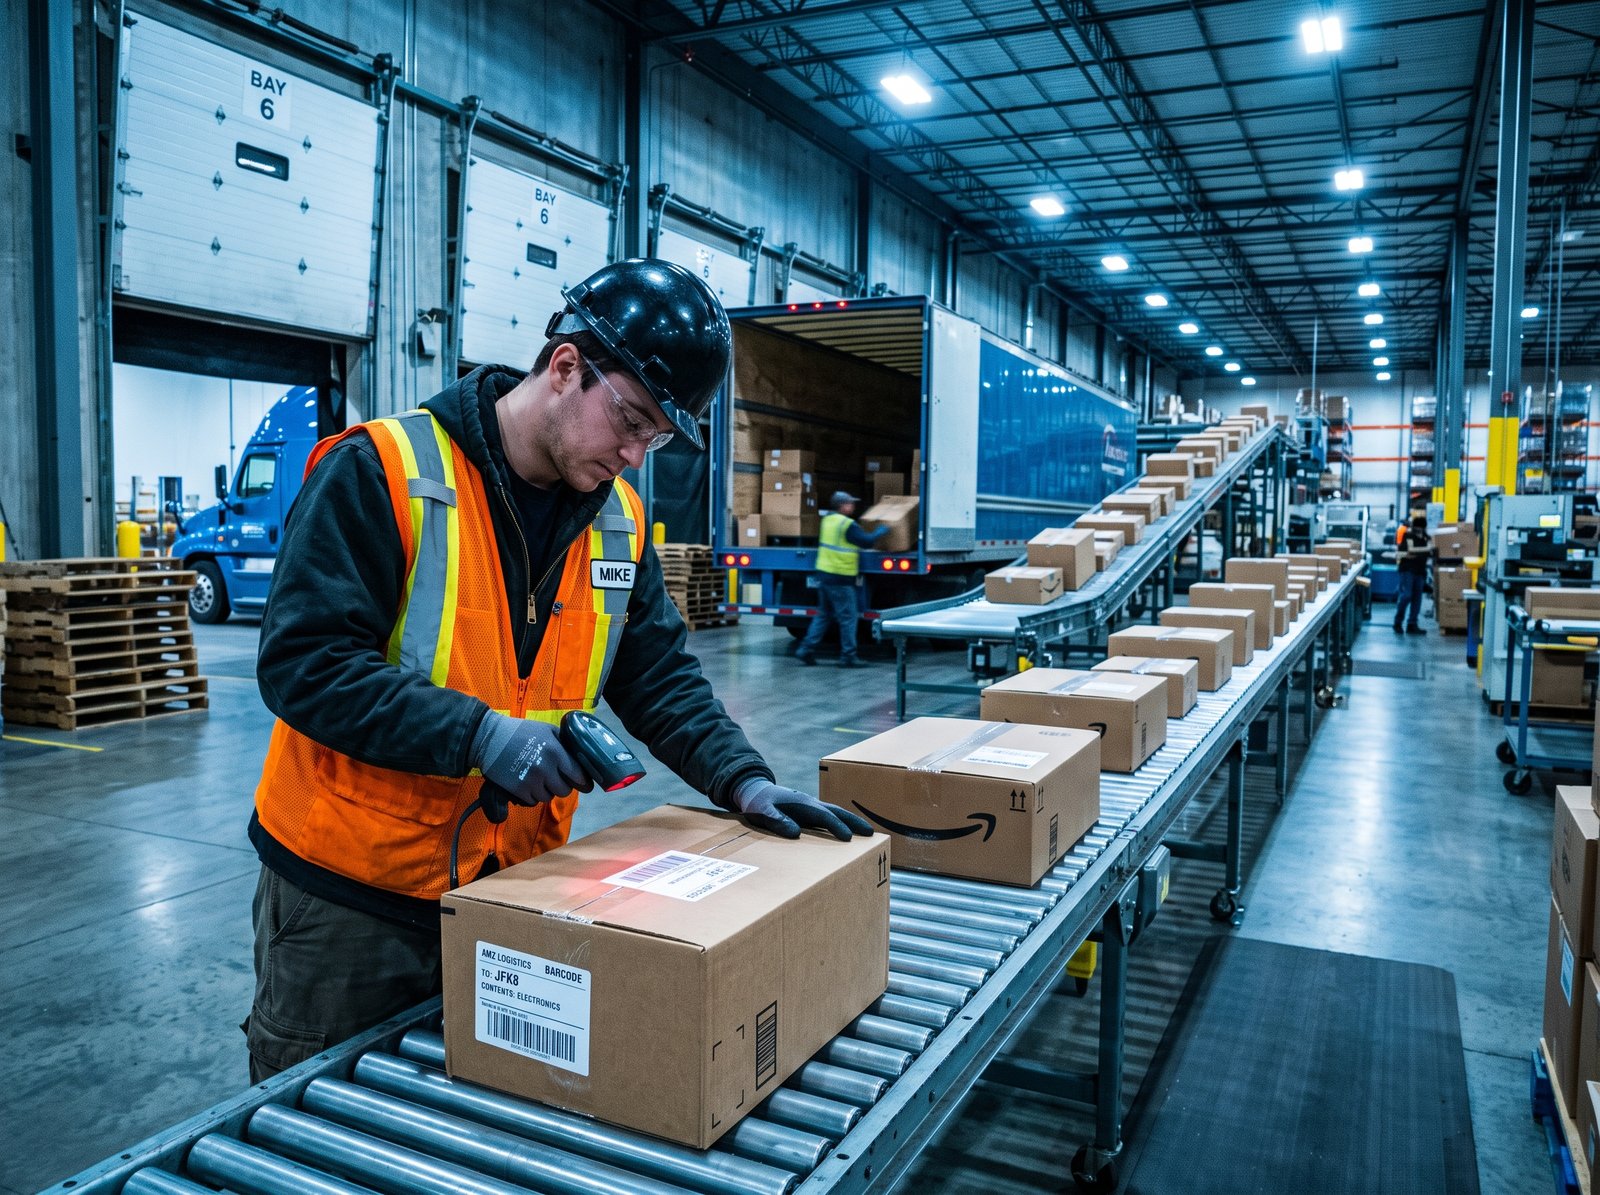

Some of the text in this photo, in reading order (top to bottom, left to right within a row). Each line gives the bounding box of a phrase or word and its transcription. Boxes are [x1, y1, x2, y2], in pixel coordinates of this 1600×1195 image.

[251, 69, 287, 96] BAY
[260, 98, 274, 121] 6
[535, 187, 556, 206] BAY
[540, 208, 549, 225] 6
[599, 567, 631, 582] MIKE
[481, 948, 532, 970] AMZ LOGISTICS
[481, 968, 519, 987] TO: JFK8
[545, 965, 582, 984] BARCODE
[481, 981, 516, 999] CONTENTS:
[517, 992, 561, 1012] ELECTRONICS
